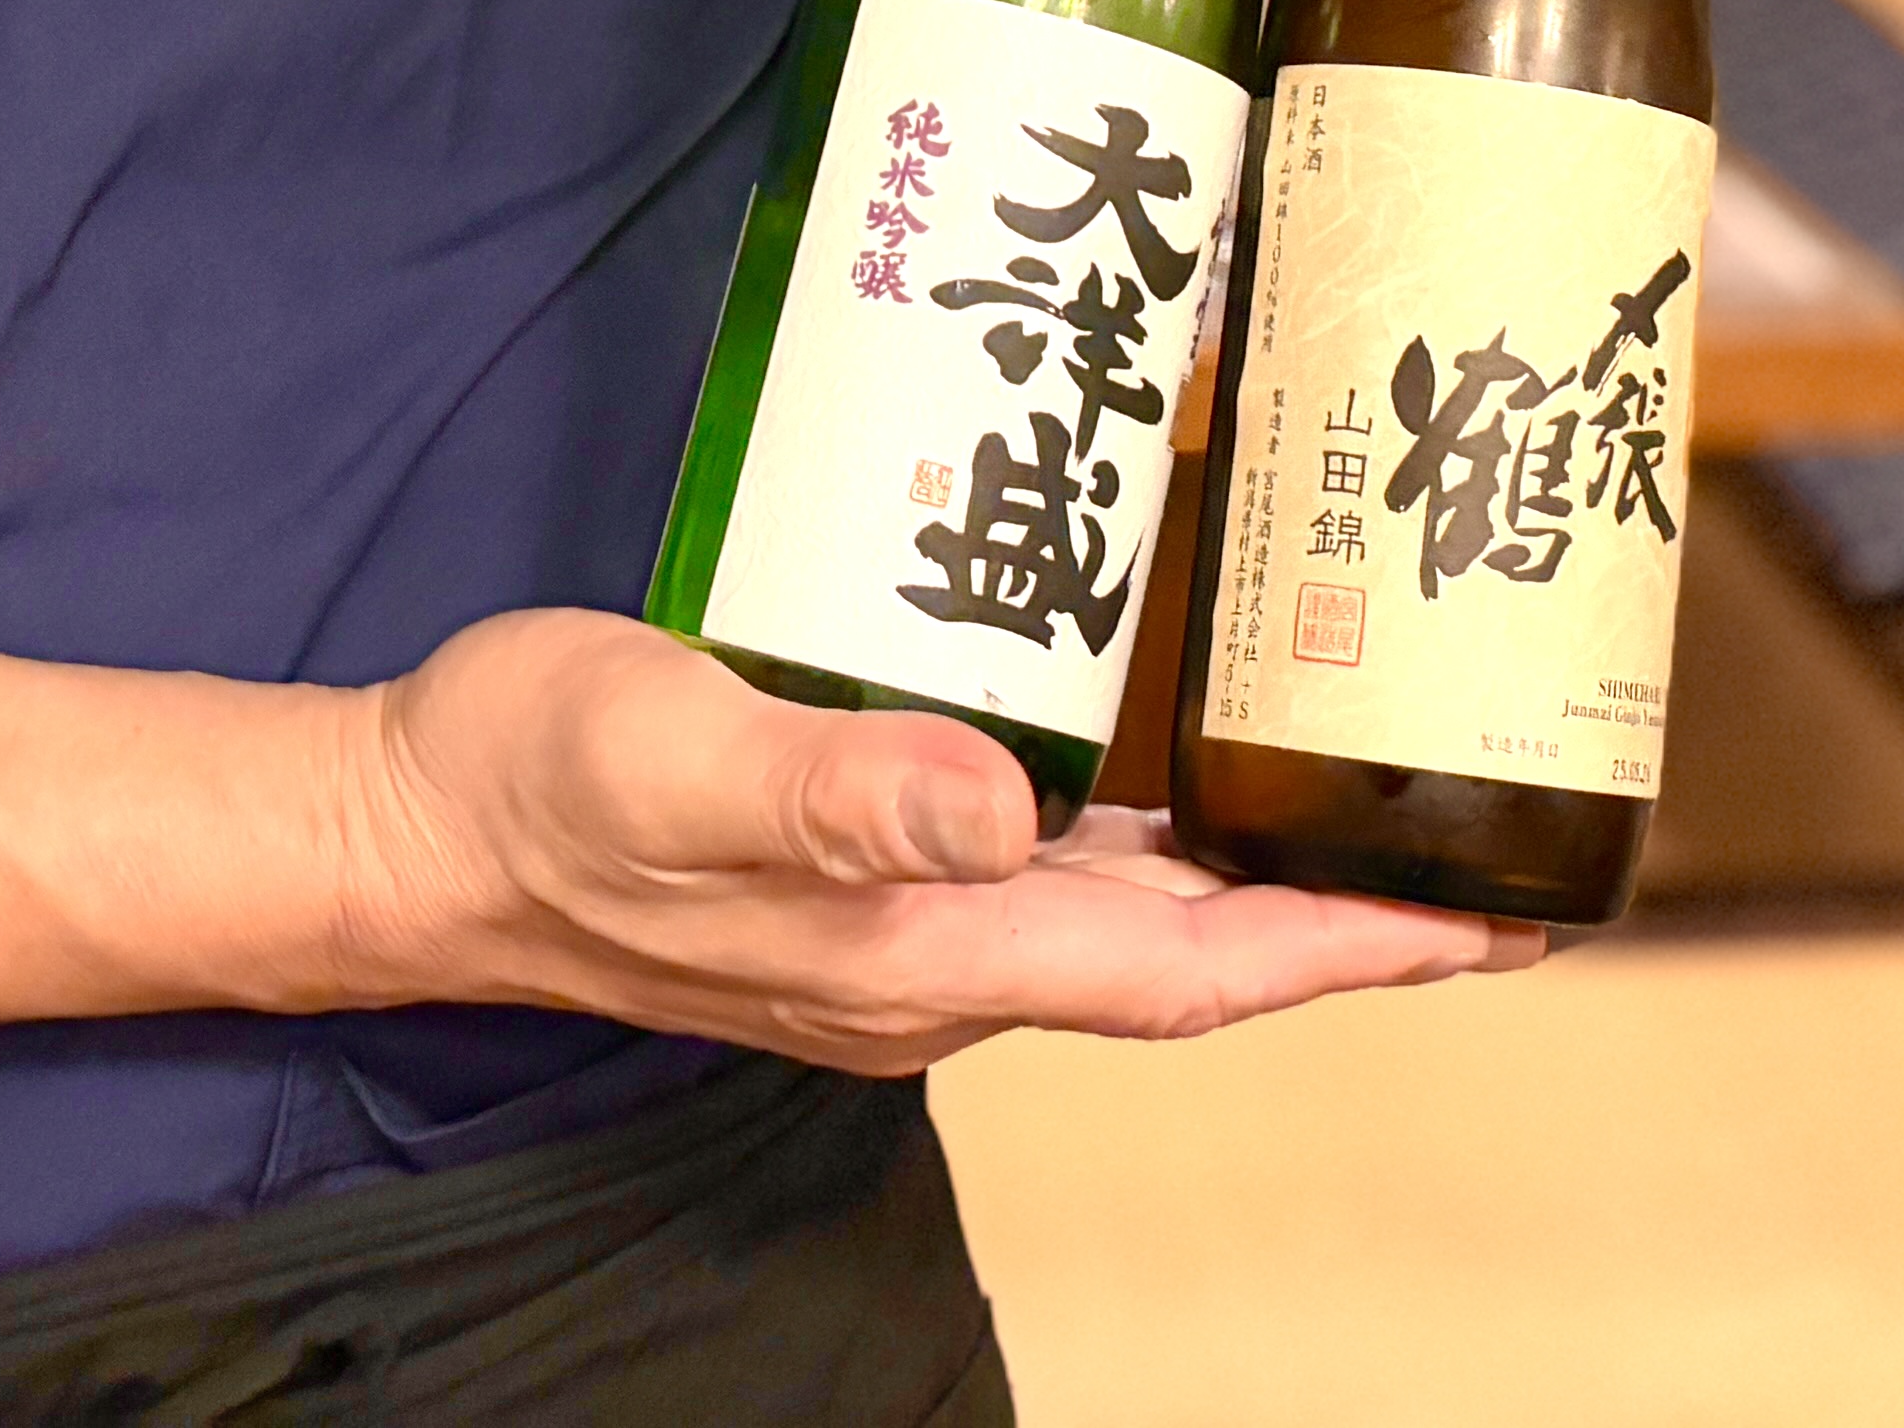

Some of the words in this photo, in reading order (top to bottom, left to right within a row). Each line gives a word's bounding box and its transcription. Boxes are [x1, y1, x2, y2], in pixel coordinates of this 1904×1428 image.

[851, 98, 953, 304] 純米吟醸
[1302, 84, 1327, 174] 日本酒
[894, 103, 1200, 657] 大洋盛
[1306, 387, 1373, 565] 山田錦
[1480, 732, 1559, 759] 製造年月日
